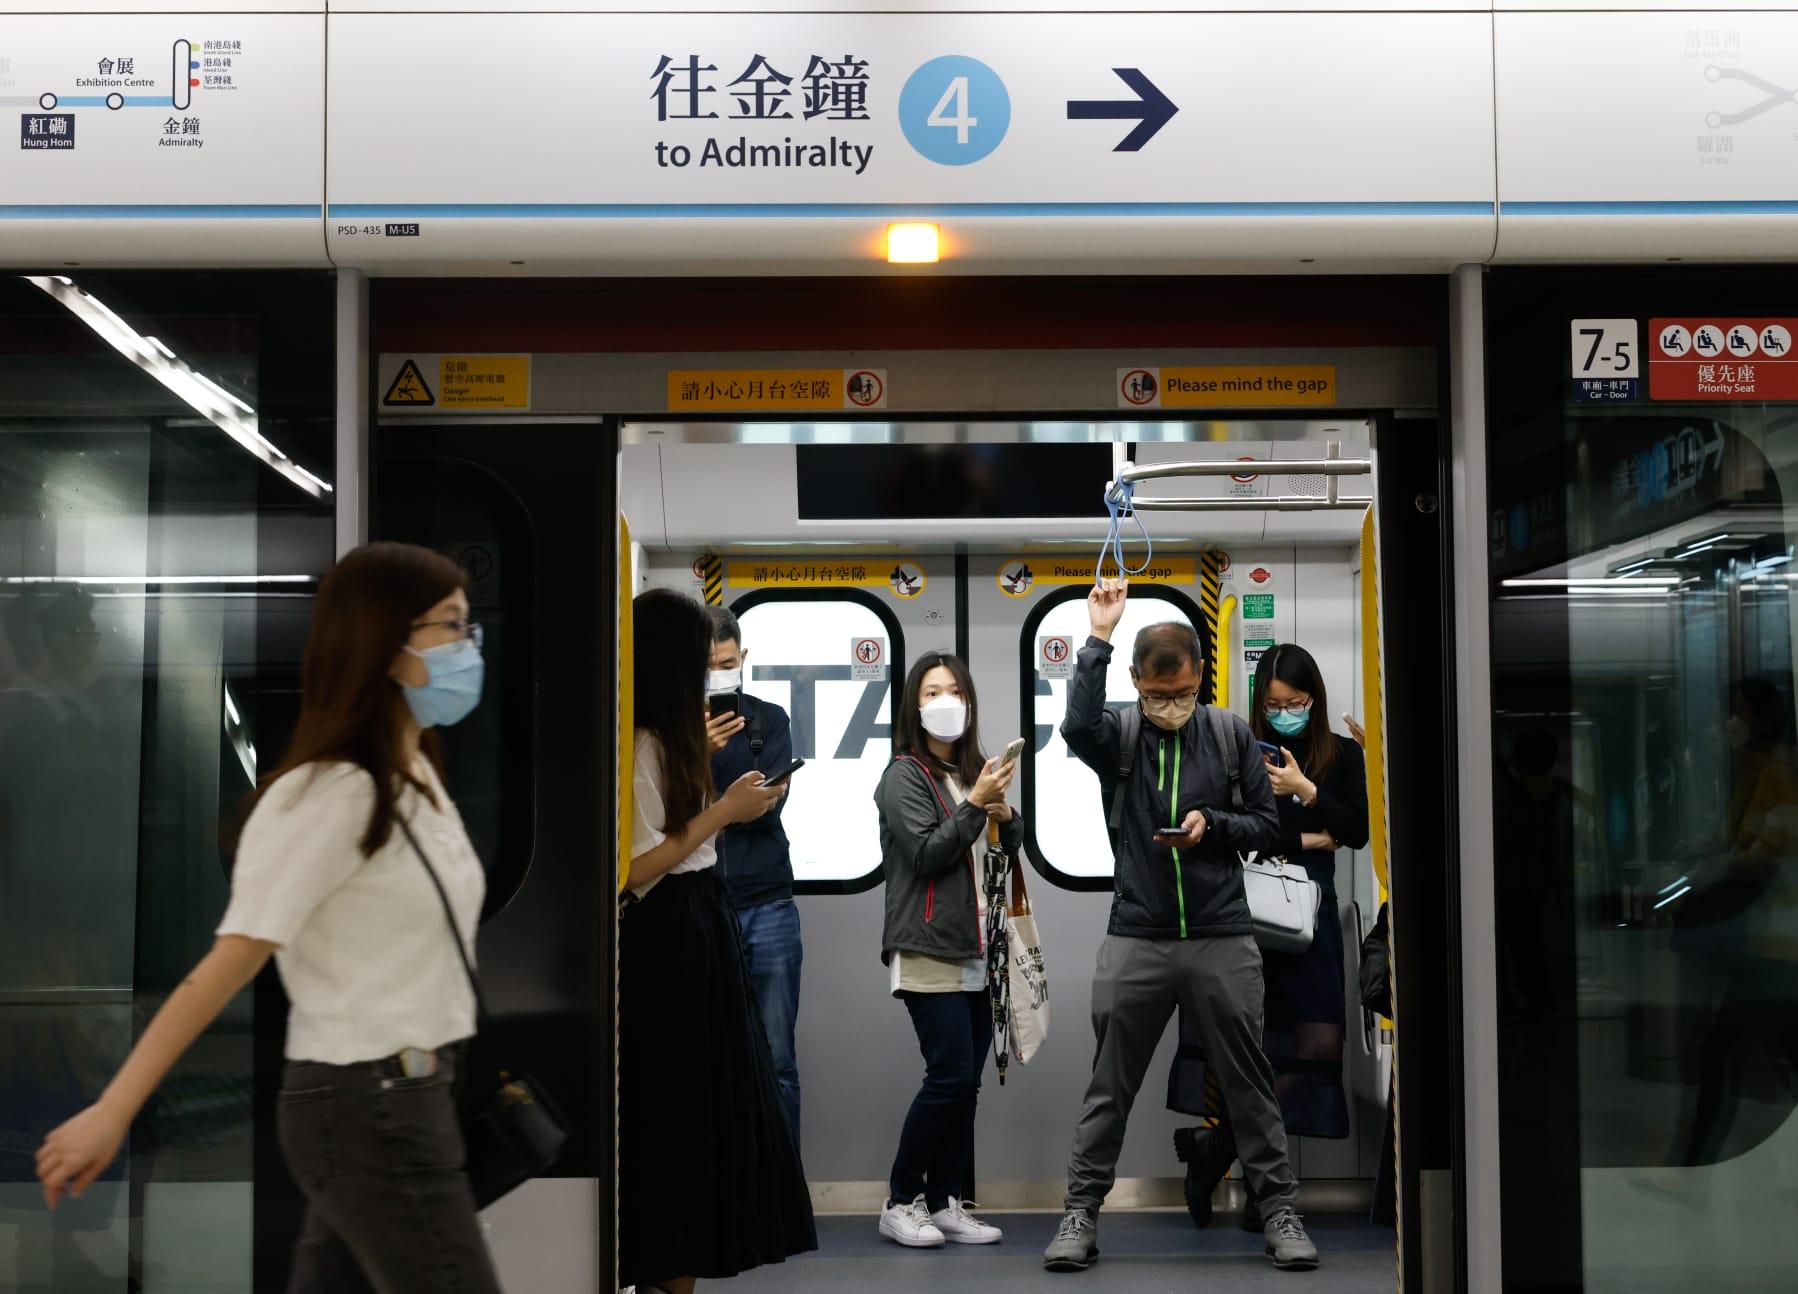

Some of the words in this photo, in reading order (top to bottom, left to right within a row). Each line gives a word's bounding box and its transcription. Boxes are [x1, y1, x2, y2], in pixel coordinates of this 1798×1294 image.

[97, 57, 135, 75] 會展
[76, 78, 122, 87] Exhibition
[124, 78, 155, 87] Centre
[650, 54, 871, 121] 往金鐘
[927, 76, 977, 144] 4
[29, 117, 67, 135] 紅磡
[163, 117, 200, 135] 金鐘
[23, 138, 49, 148] Hung
[50, 138, 72, 147] Hom
[158, 137, 204, 148] Admiralty
[655, 141, 691, 168] to
[700, 137, 873, 175] Admiralty
[1579, 328, 1630, 371] 7-5
[1698, 364, 1755, 382] 優先座
[444, 387, 470, 395] Danger
[681, 381, 832, 400] 請小心月台空隙
[1167, 377, 1217, 392] Please
[1222, 377, 1263, 391] mind
[1267, 377, 1293, 391] the
[1297, 379, 1328, 394] gap
[1698, 383, 1733, 394] Priority
[1734, 383, 1755, 393] Seat
[1590, 391, 1602, 399] Car
[1609, 391, 1628, 399] Door
[753, 566, 867, 583] 請小心月台空隙
[1054, 566, 1091, 577] Please
[1152, 568, 1172, 579] gap
